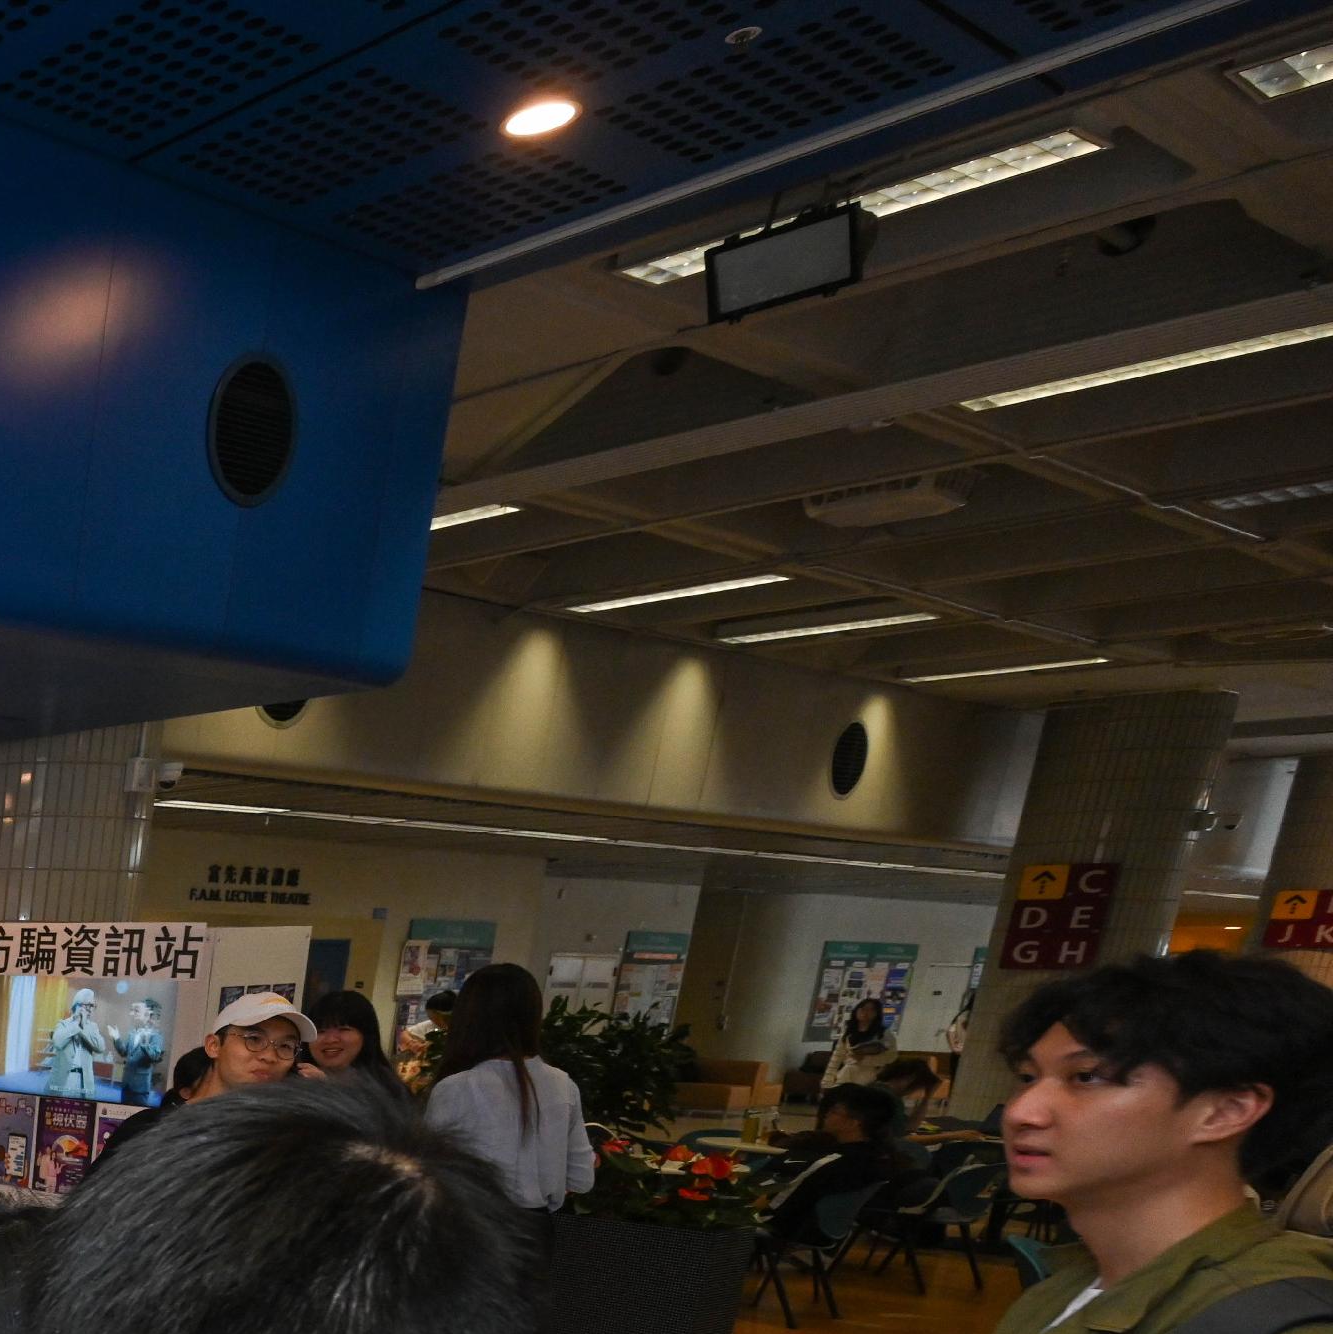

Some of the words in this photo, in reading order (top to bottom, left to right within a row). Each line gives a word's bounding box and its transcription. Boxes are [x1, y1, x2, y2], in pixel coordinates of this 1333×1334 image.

[225, 889, 267, 904] LECTURE
[270, 891, 312, 906] THEATRE
[1018, 906, 1048, 930] D
[1069, 905, 1094, 929] E
[1012, 939, 1040, 965] G
[1057, 940, 1088, 965] H
